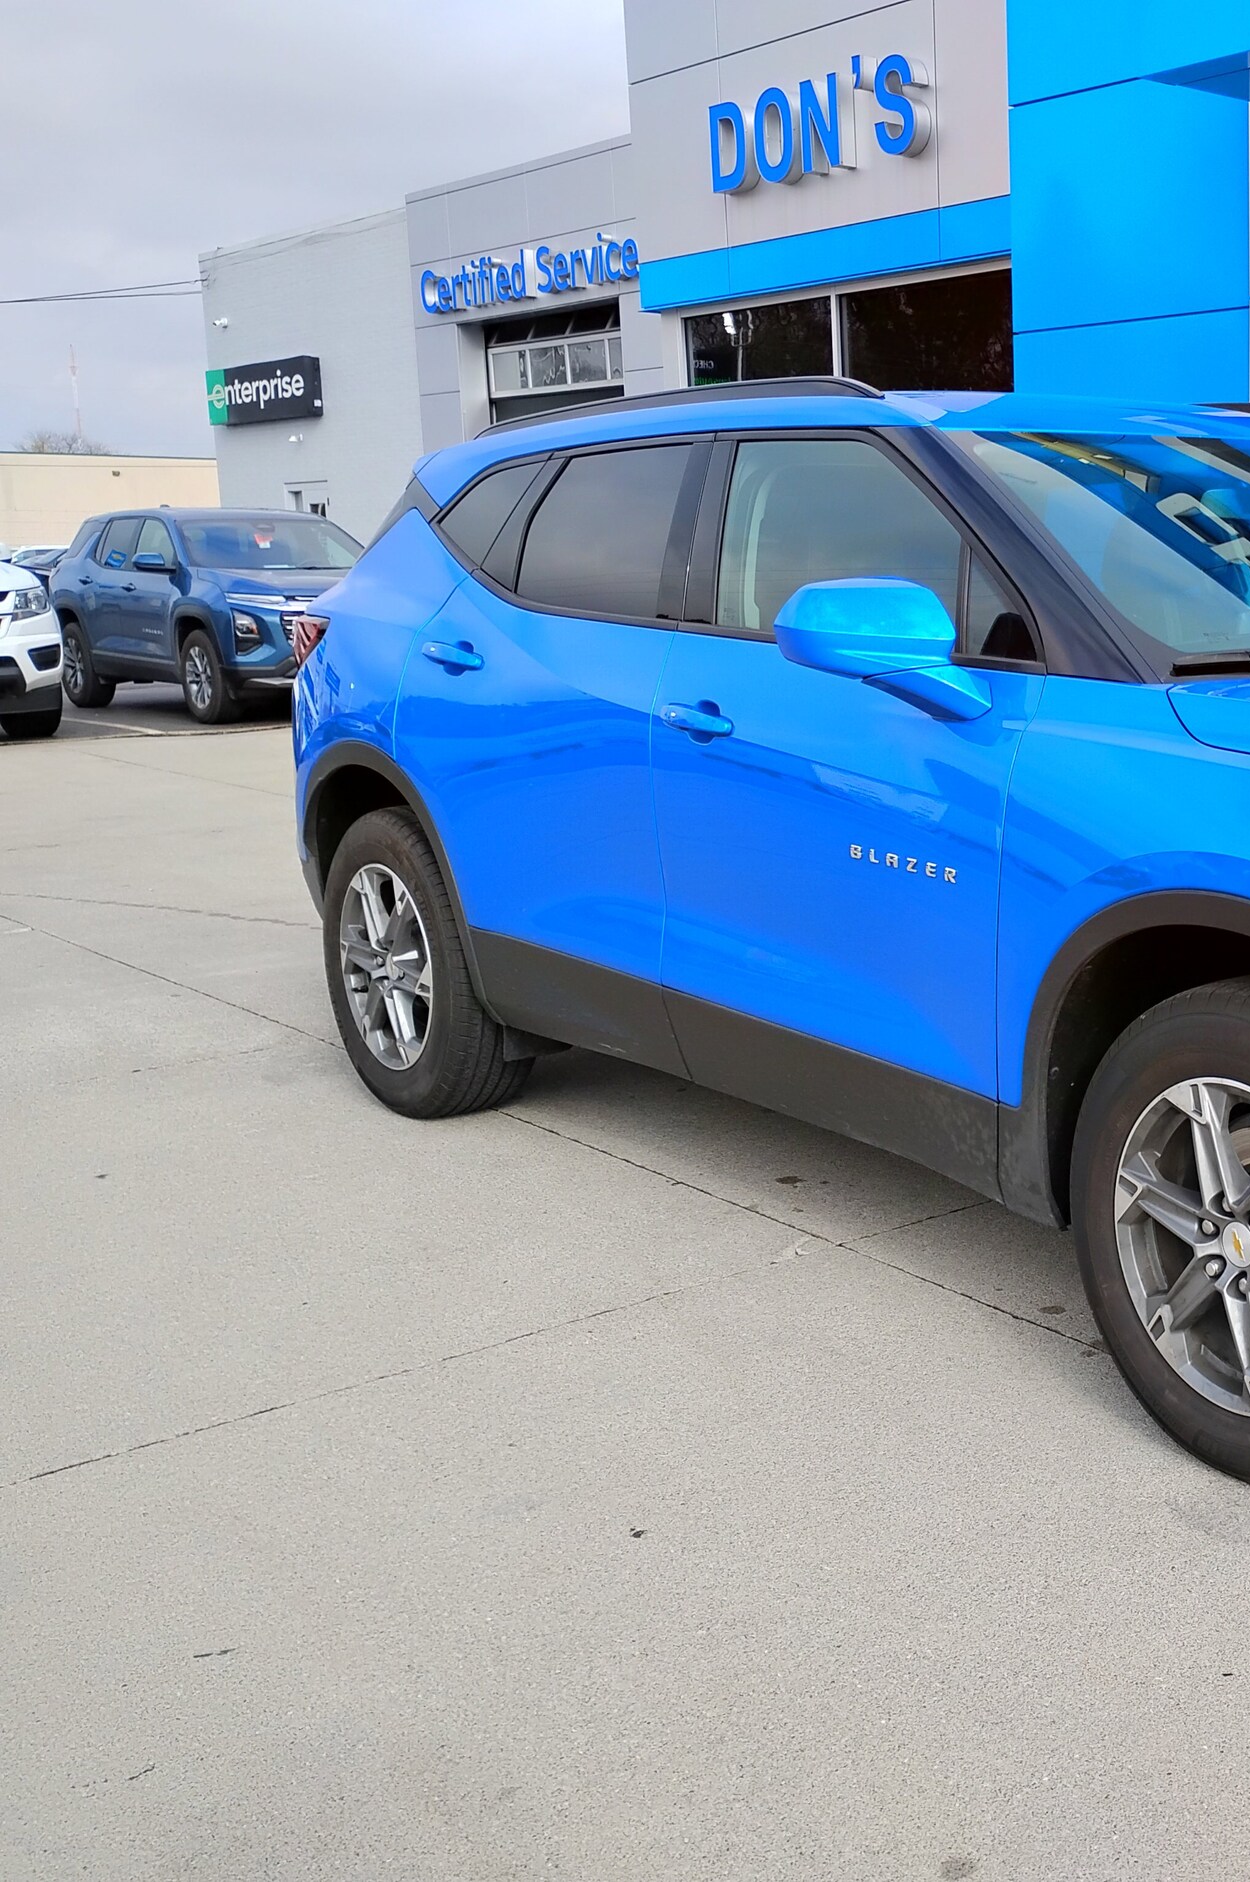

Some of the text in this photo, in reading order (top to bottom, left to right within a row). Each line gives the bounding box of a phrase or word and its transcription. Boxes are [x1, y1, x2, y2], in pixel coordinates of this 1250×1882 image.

[708, 53, 926, 194] DON'S
[420, 231, 640, 314] Certified Service
[207, 368, 305, 410] enterprise
[849, 844, 957, 884] BLAZER
